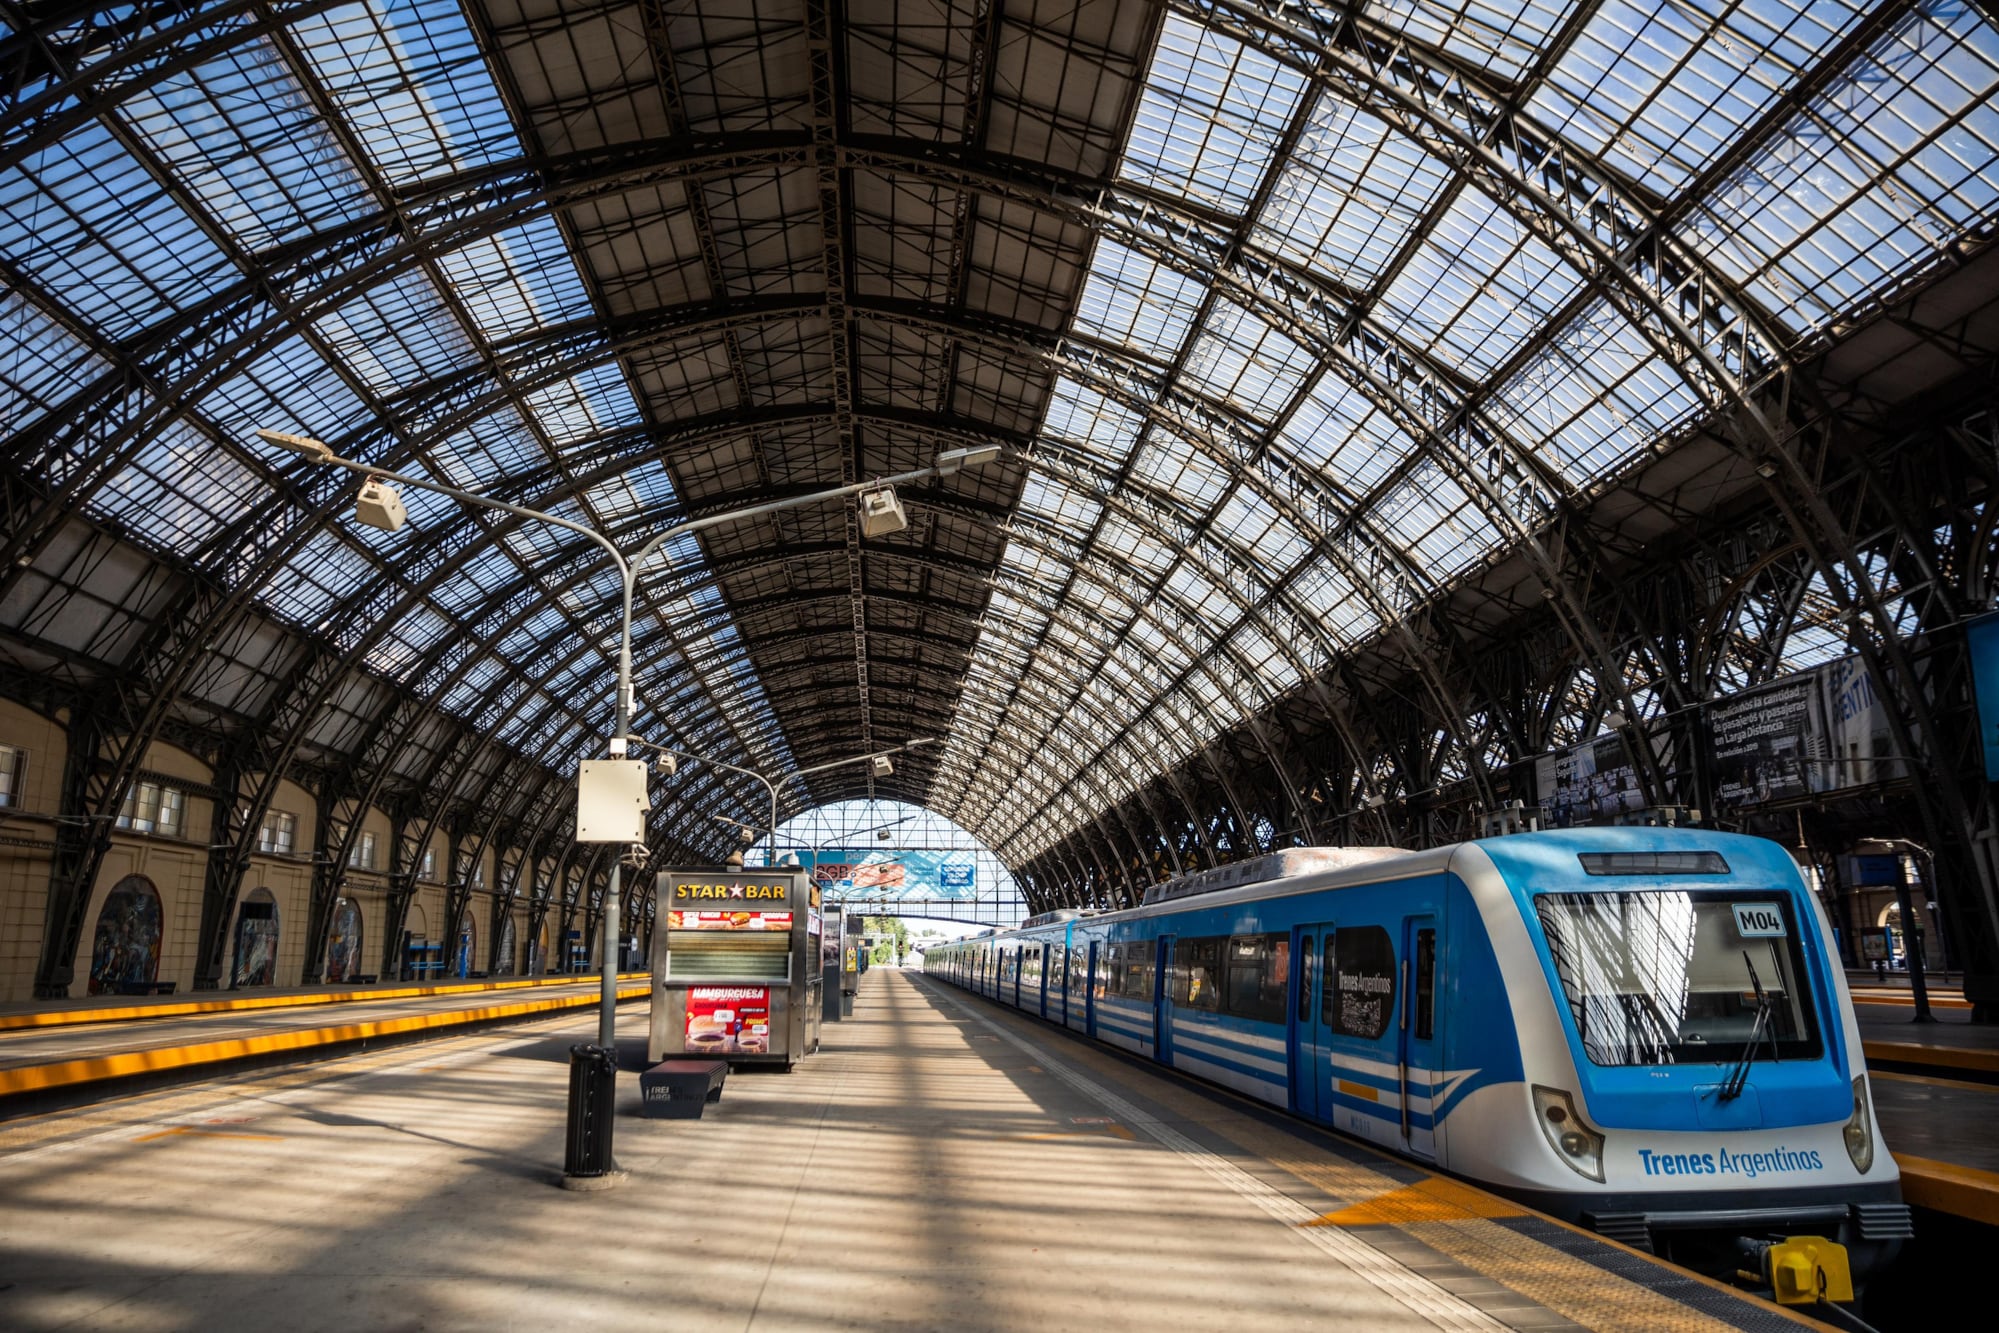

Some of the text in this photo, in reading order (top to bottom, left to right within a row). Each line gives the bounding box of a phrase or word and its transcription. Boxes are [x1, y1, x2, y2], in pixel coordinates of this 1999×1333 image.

[1711, 685, 1800, 720] Duplicamos la cantidad
[1713, 722, 1722, 733] de
[1722, 713, 1758, 734] pasajeros
[1767, 700, 1806, 720] pasajeras
[1714, 721, 1785, 746] en Larga Distancia
[677, 884, 785, 899] STAR BAR
[1739, 911, 1780, 930] M04
[692, 987, 765, 999] HAMBURGUESA
[1338, 970, 1391, 996] Trenes Argentinos
[1638, 1146, 1823, 1178] Trenes Argentinos
